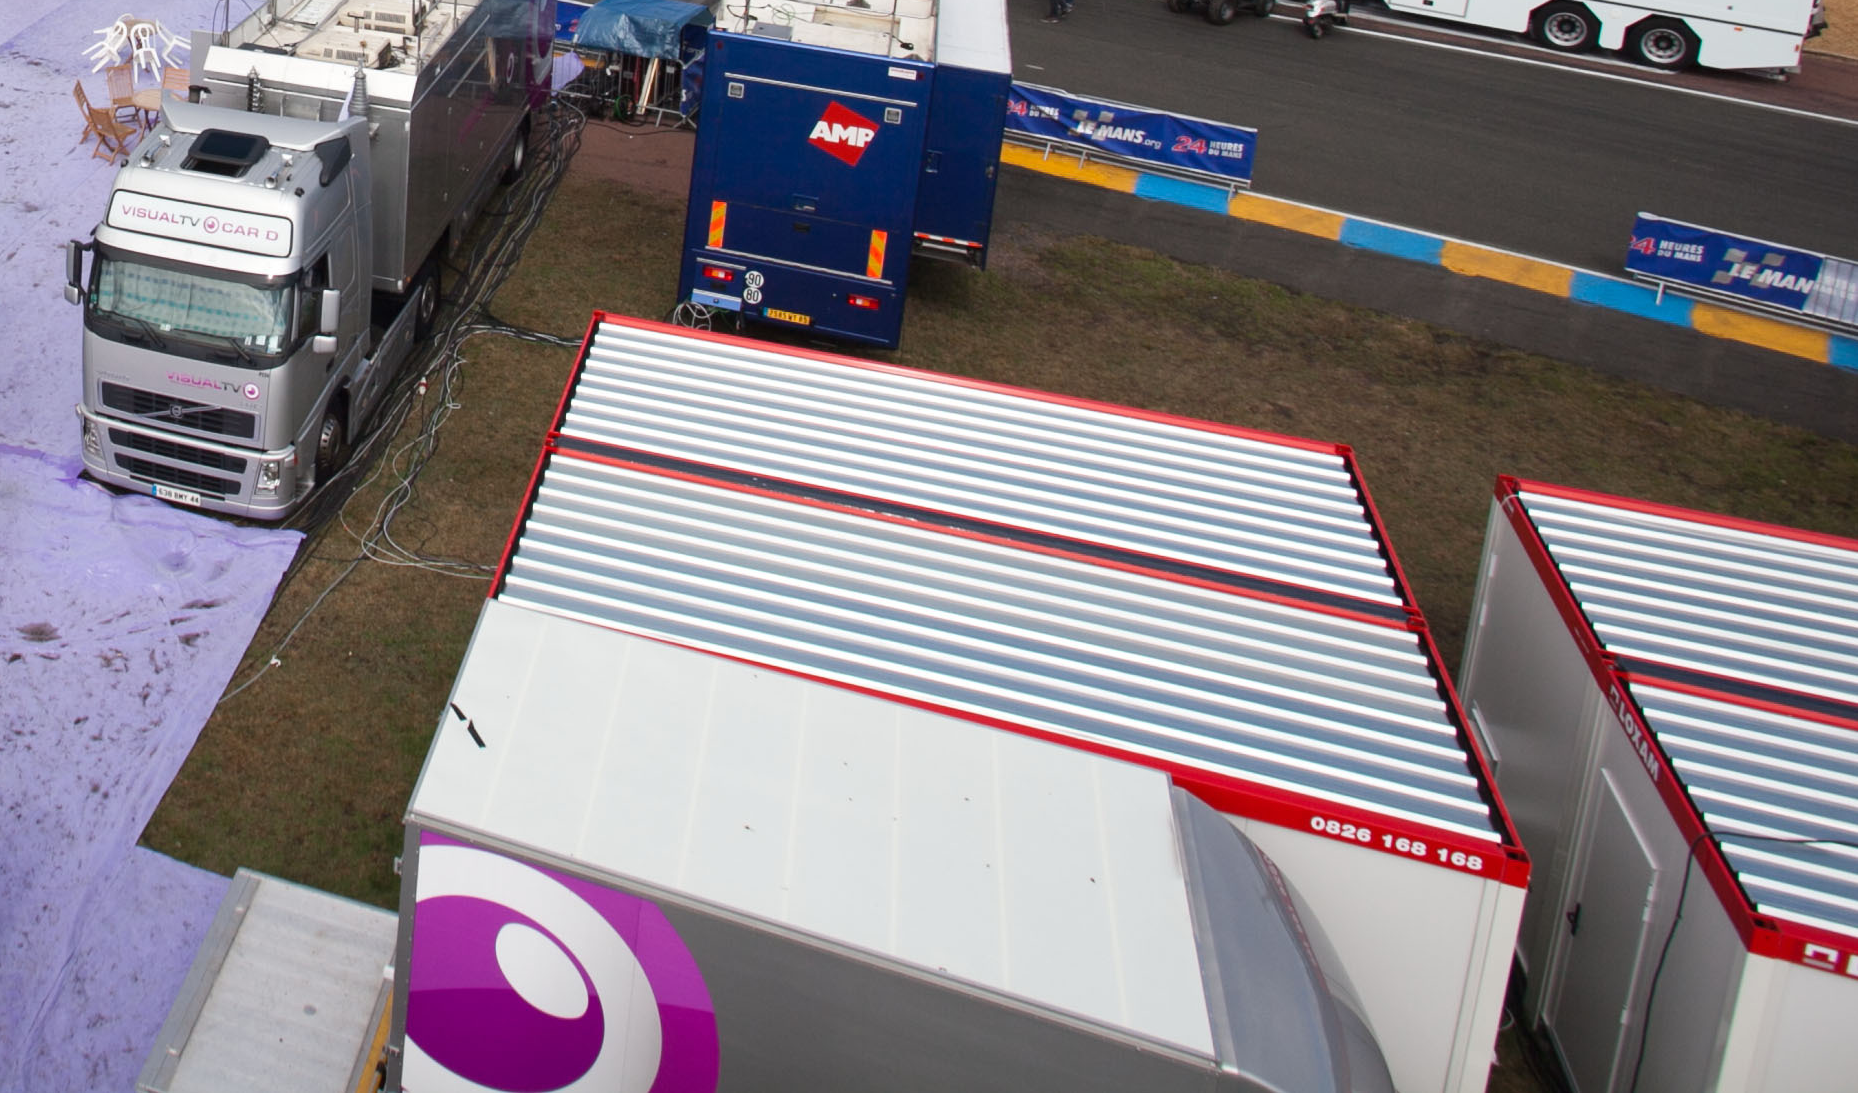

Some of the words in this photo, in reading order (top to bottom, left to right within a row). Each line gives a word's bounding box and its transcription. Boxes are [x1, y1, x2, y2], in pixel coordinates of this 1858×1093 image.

[809, 120, 874, 148] AMP
[1077, 121, 1095, 134] LE
[1097, 124, 1162, 150] MANS.org
[1171, 136, 1208, 154] 24
[1208, 148, 1220, 156] DU
[1221, 150, 1242, 159] MANS
[1210, 141, 1244, 153] HEURES
[122, 205, 200, 227] VISUALTV
[221, 222, 259, 239] CAR
[266, 230, 279, 242] D
[1657, 249, 1671, 258] DU
[1673, 252, 1702, 262] MANS
[1659, 240, 1704, 254] HEURES
[1729, 263, 1759, 280] LE
[747, 274, 761, 287] 90
[746, 289, 759, 302] 80
[165, 371, 242, 394] VISUALTV
[1620, 711, 1660, 782] LOXAM
[1310, 816, 1372, 842] 0826
[1382, 834, 1427, 856] 168
[1437, 848, 1483, 871] 168
